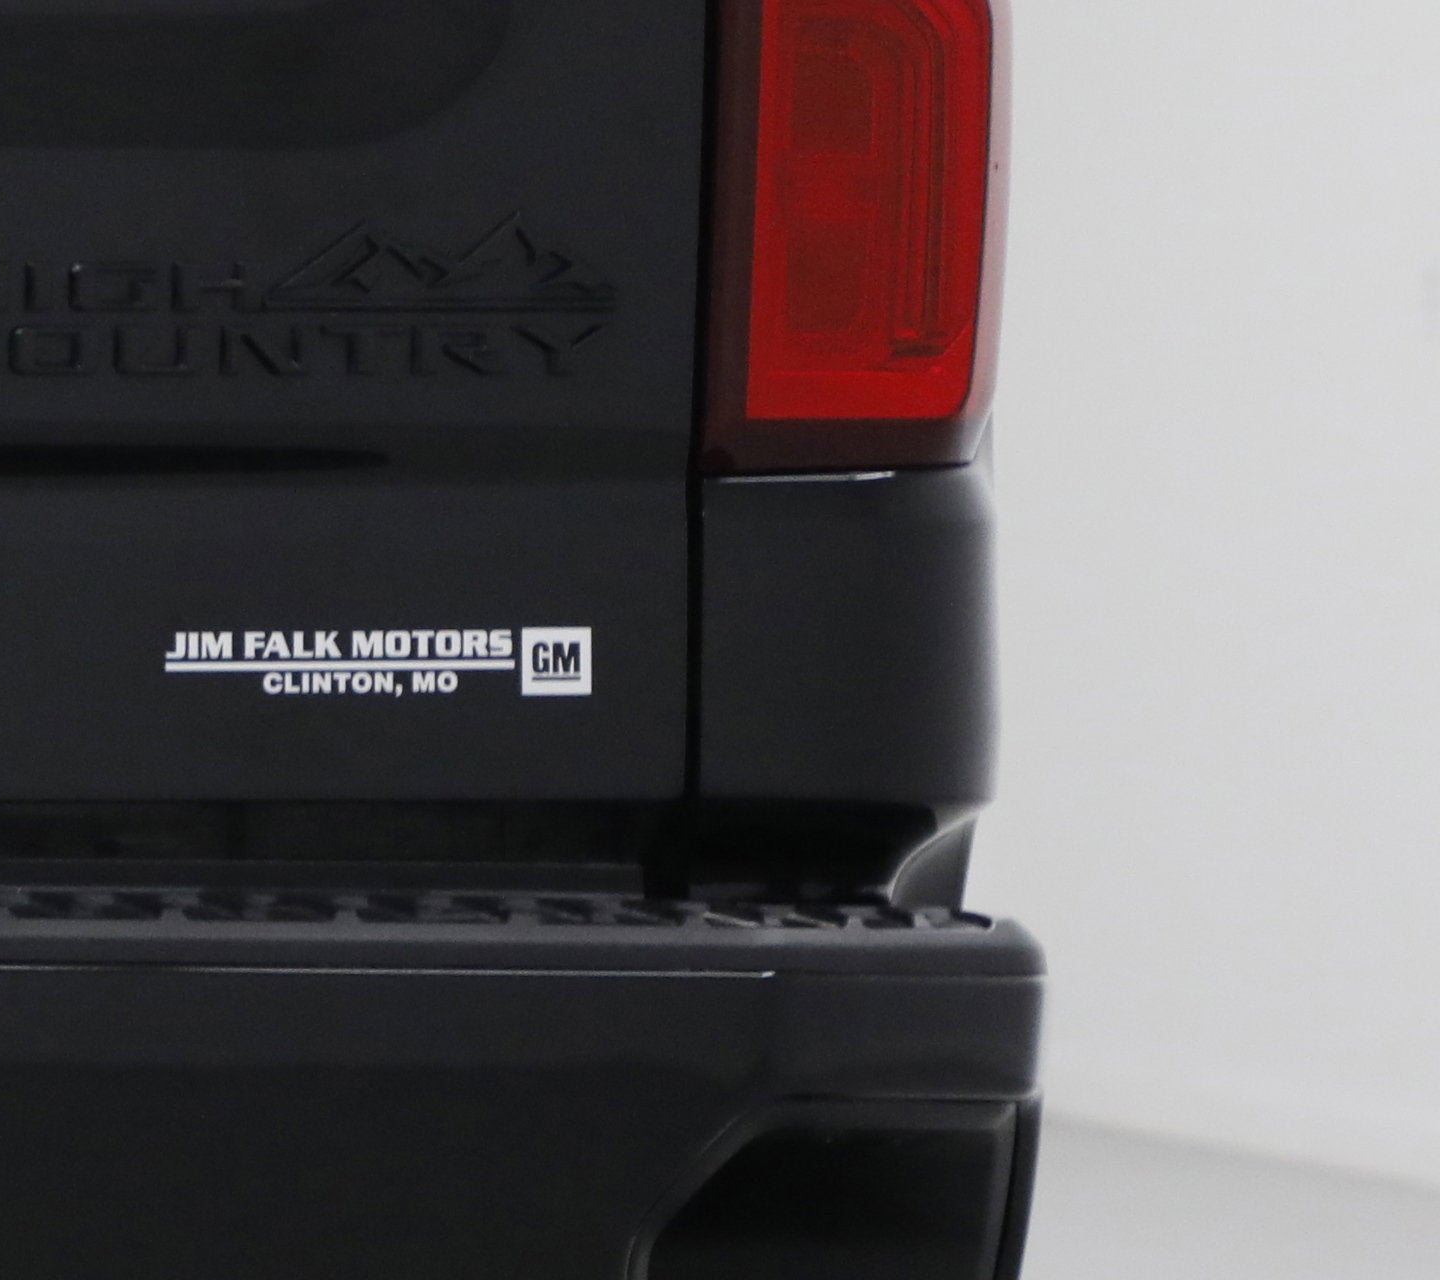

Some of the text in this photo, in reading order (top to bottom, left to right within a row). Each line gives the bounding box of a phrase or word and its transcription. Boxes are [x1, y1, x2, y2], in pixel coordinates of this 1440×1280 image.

[165, 628, 513, 659] JIM FALK MOTORS
[531, 641, 581, 673] GM
[262, 670, 459, 698] CLINTON, MO
